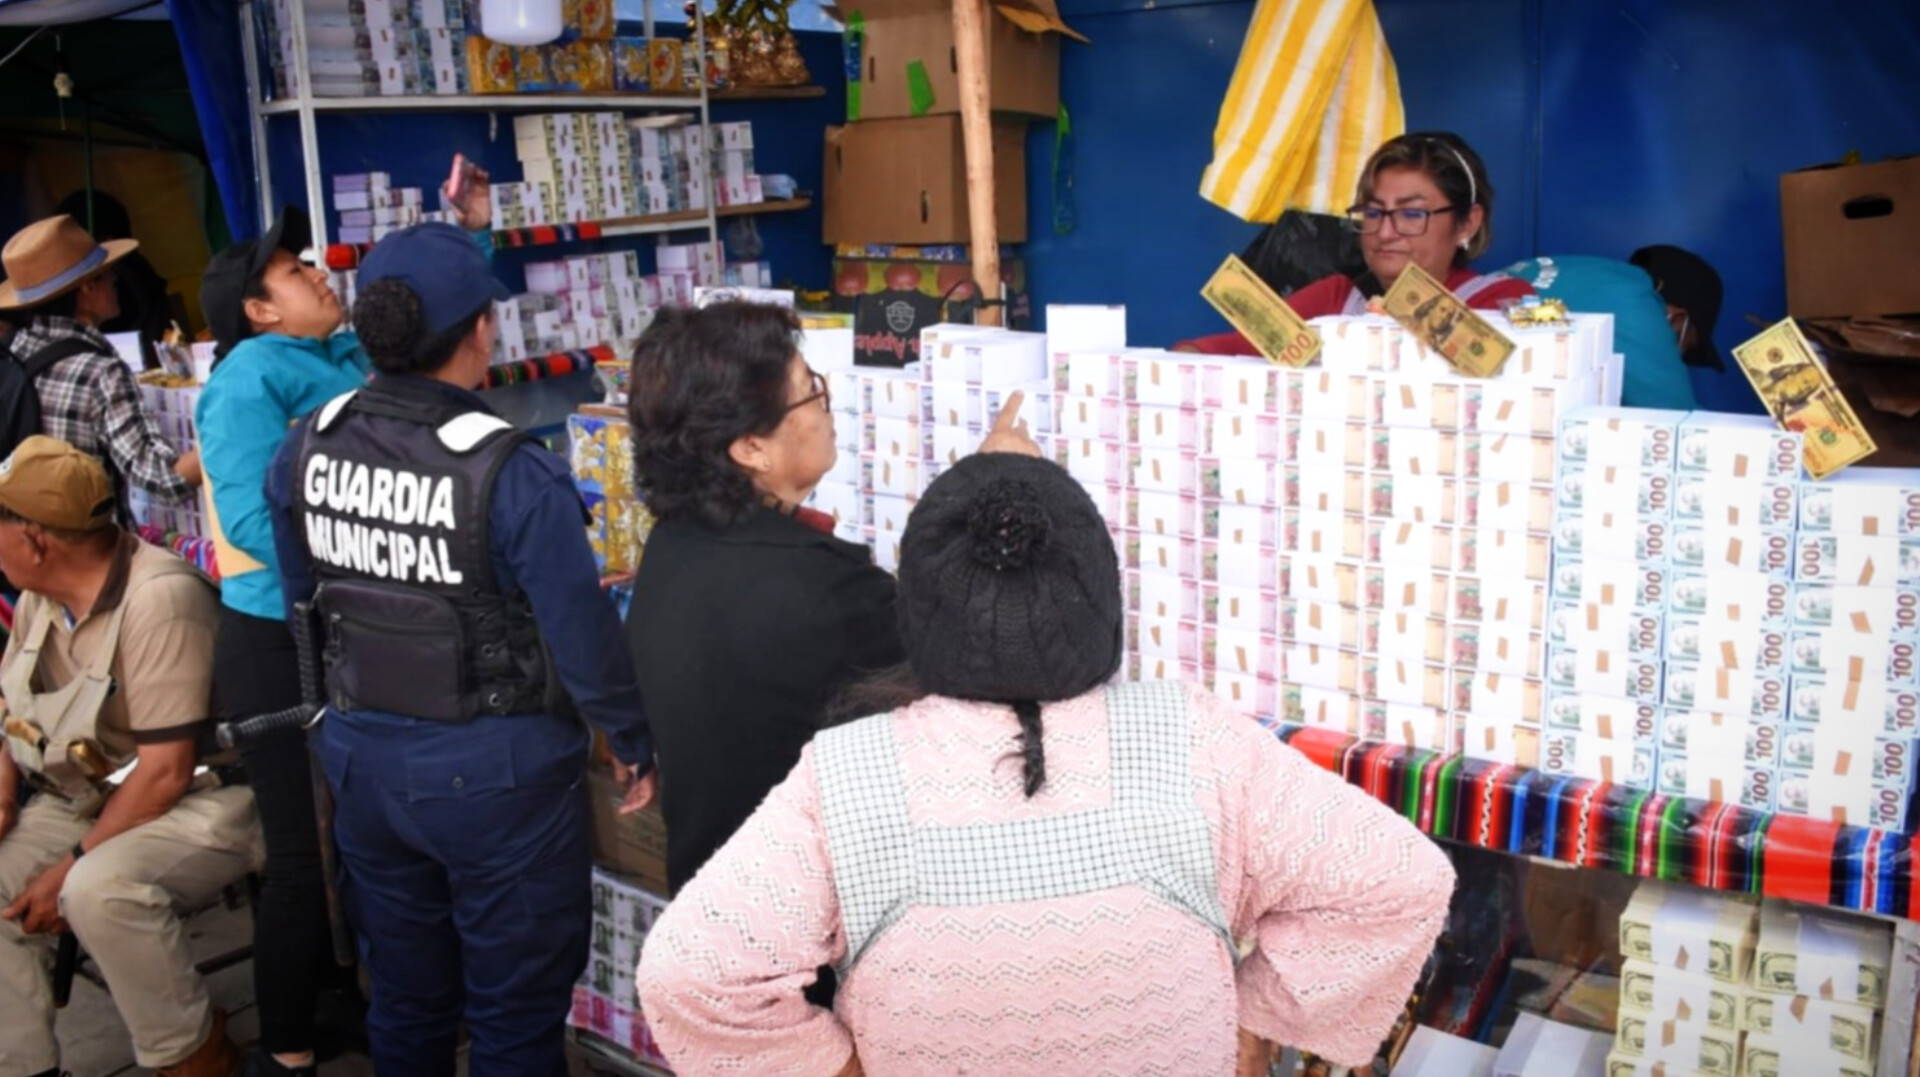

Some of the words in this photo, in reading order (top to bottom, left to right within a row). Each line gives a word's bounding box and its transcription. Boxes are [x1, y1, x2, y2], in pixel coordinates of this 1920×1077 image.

[1280, 334, 1312, 365] 100
[1654, 429, 1670, 464] 100
[1778, 438, 1796, 475] 100
[304, 453, 456, 530] GUARDIA
[1650, 476, 1667, 511] 100
[1774, 486, 1791, 523] 100
[1908, 492, 1920, 531] 100
[305, 512, 462, 584] MUNICIPAL
[1647, 524, 1664, 558] 100
[1769, 535, 1787, 571] 100
[1802, 541, 1820, 576] 100
[1646, 571, 1662, 604] 100
[1767, 584, 1786, 622] 100
[1897, 593, 1918, 631] 100
[1639, 617, 1656, 651] 100
[1766, 633, 1784, 670] 100
[1893, 643, 1913, 680] 100
[1639, 663, 1655, 697] 100
[1763, 679, 1781, 716] 100
[1637, 705, 1654, 738] 100
[1897, 694, 1916, 731] 100
[1547, 739, 1563, 770] 100
[1757, 725, 1774, 761] 100
[1884, 742, 1903, 779] 100
[1754, 771, 1770, 805] 100
[1880, 789, 1900, 826] 100
